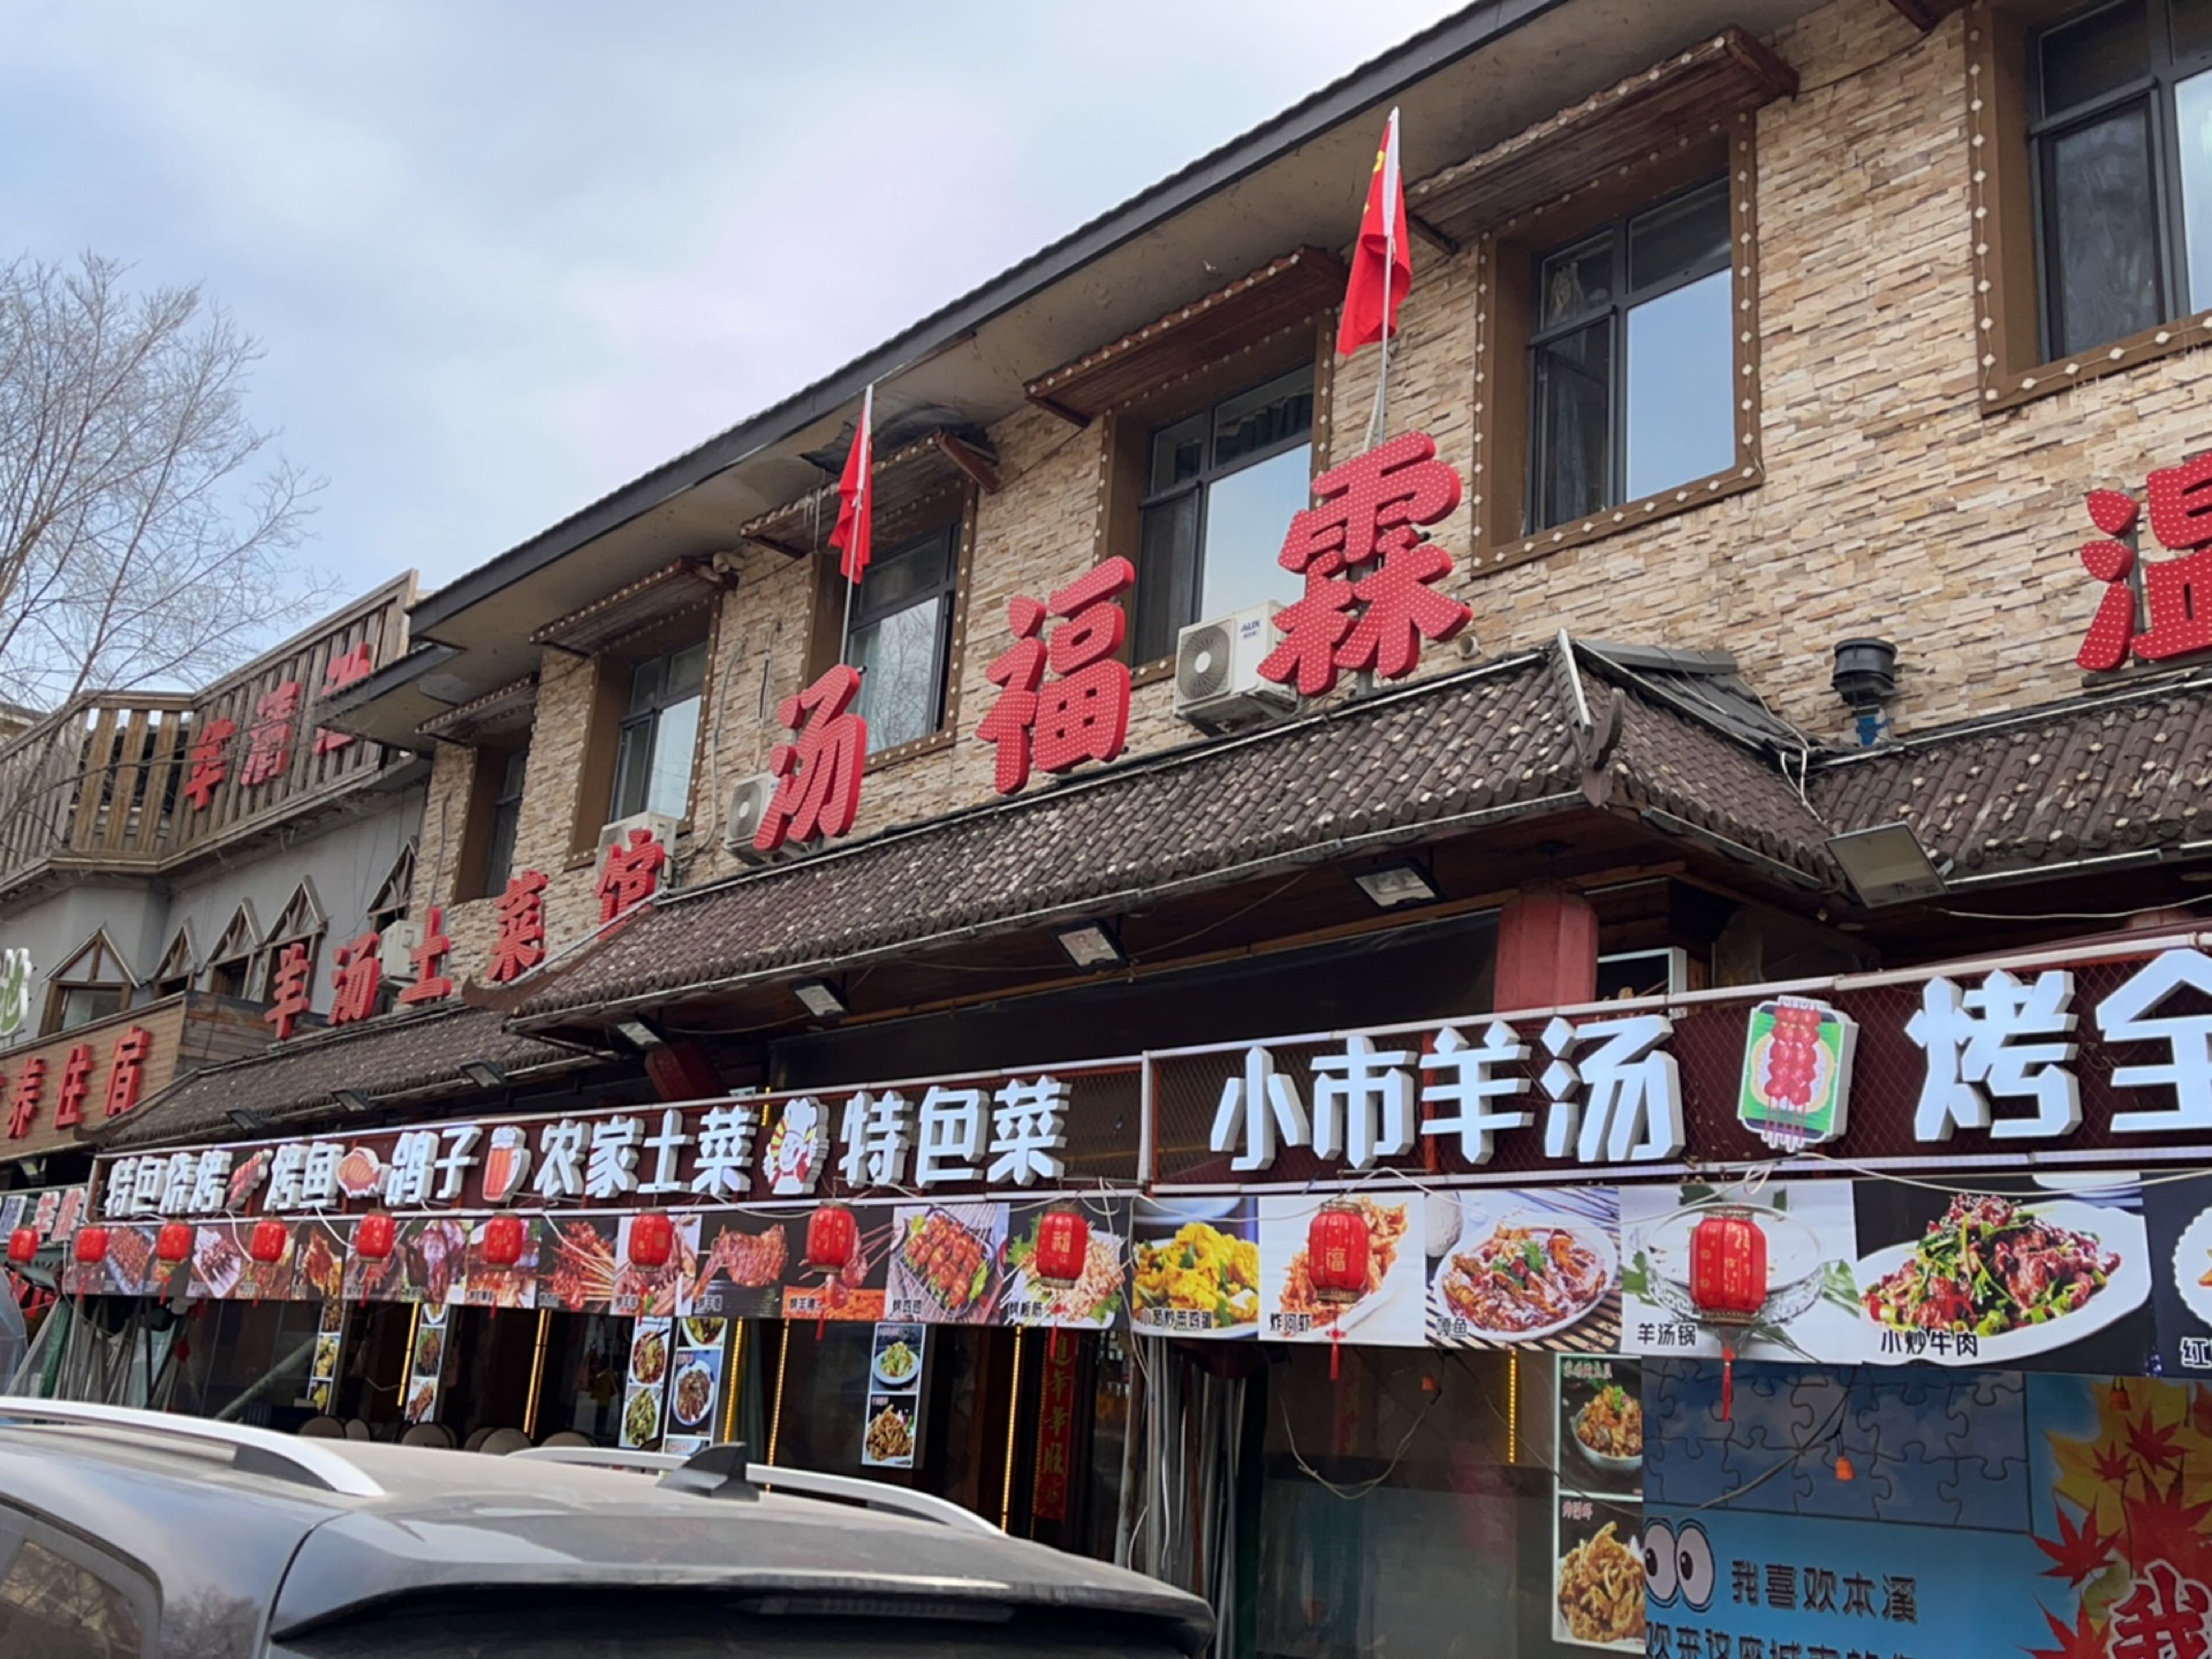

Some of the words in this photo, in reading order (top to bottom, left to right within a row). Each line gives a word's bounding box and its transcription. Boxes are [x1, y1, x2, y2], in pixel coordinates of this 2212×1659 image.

[754, 430, 1473, 851] 汤福霖
[0, 1025, 152, 1139] 养住宿
[1210, 1014, 1686, 1171] 小市羊汤
[1904, 949, 2212, 1142] 烤全
[264, 1141, 344, 1211] 烤鱼
[386, 1125, 482, 1207] 鸽子
[534, 1105, 758, 1199] 农家土菜
[840, 1075, 1070, 1189] 特色菜
[1637, 1322, 1697, 1347] 羊汤锅
[1879, 1330, 1979, 1358] 小炒牛肉
[1731, 1559, 1918, 1624] 我喜欢本溪
